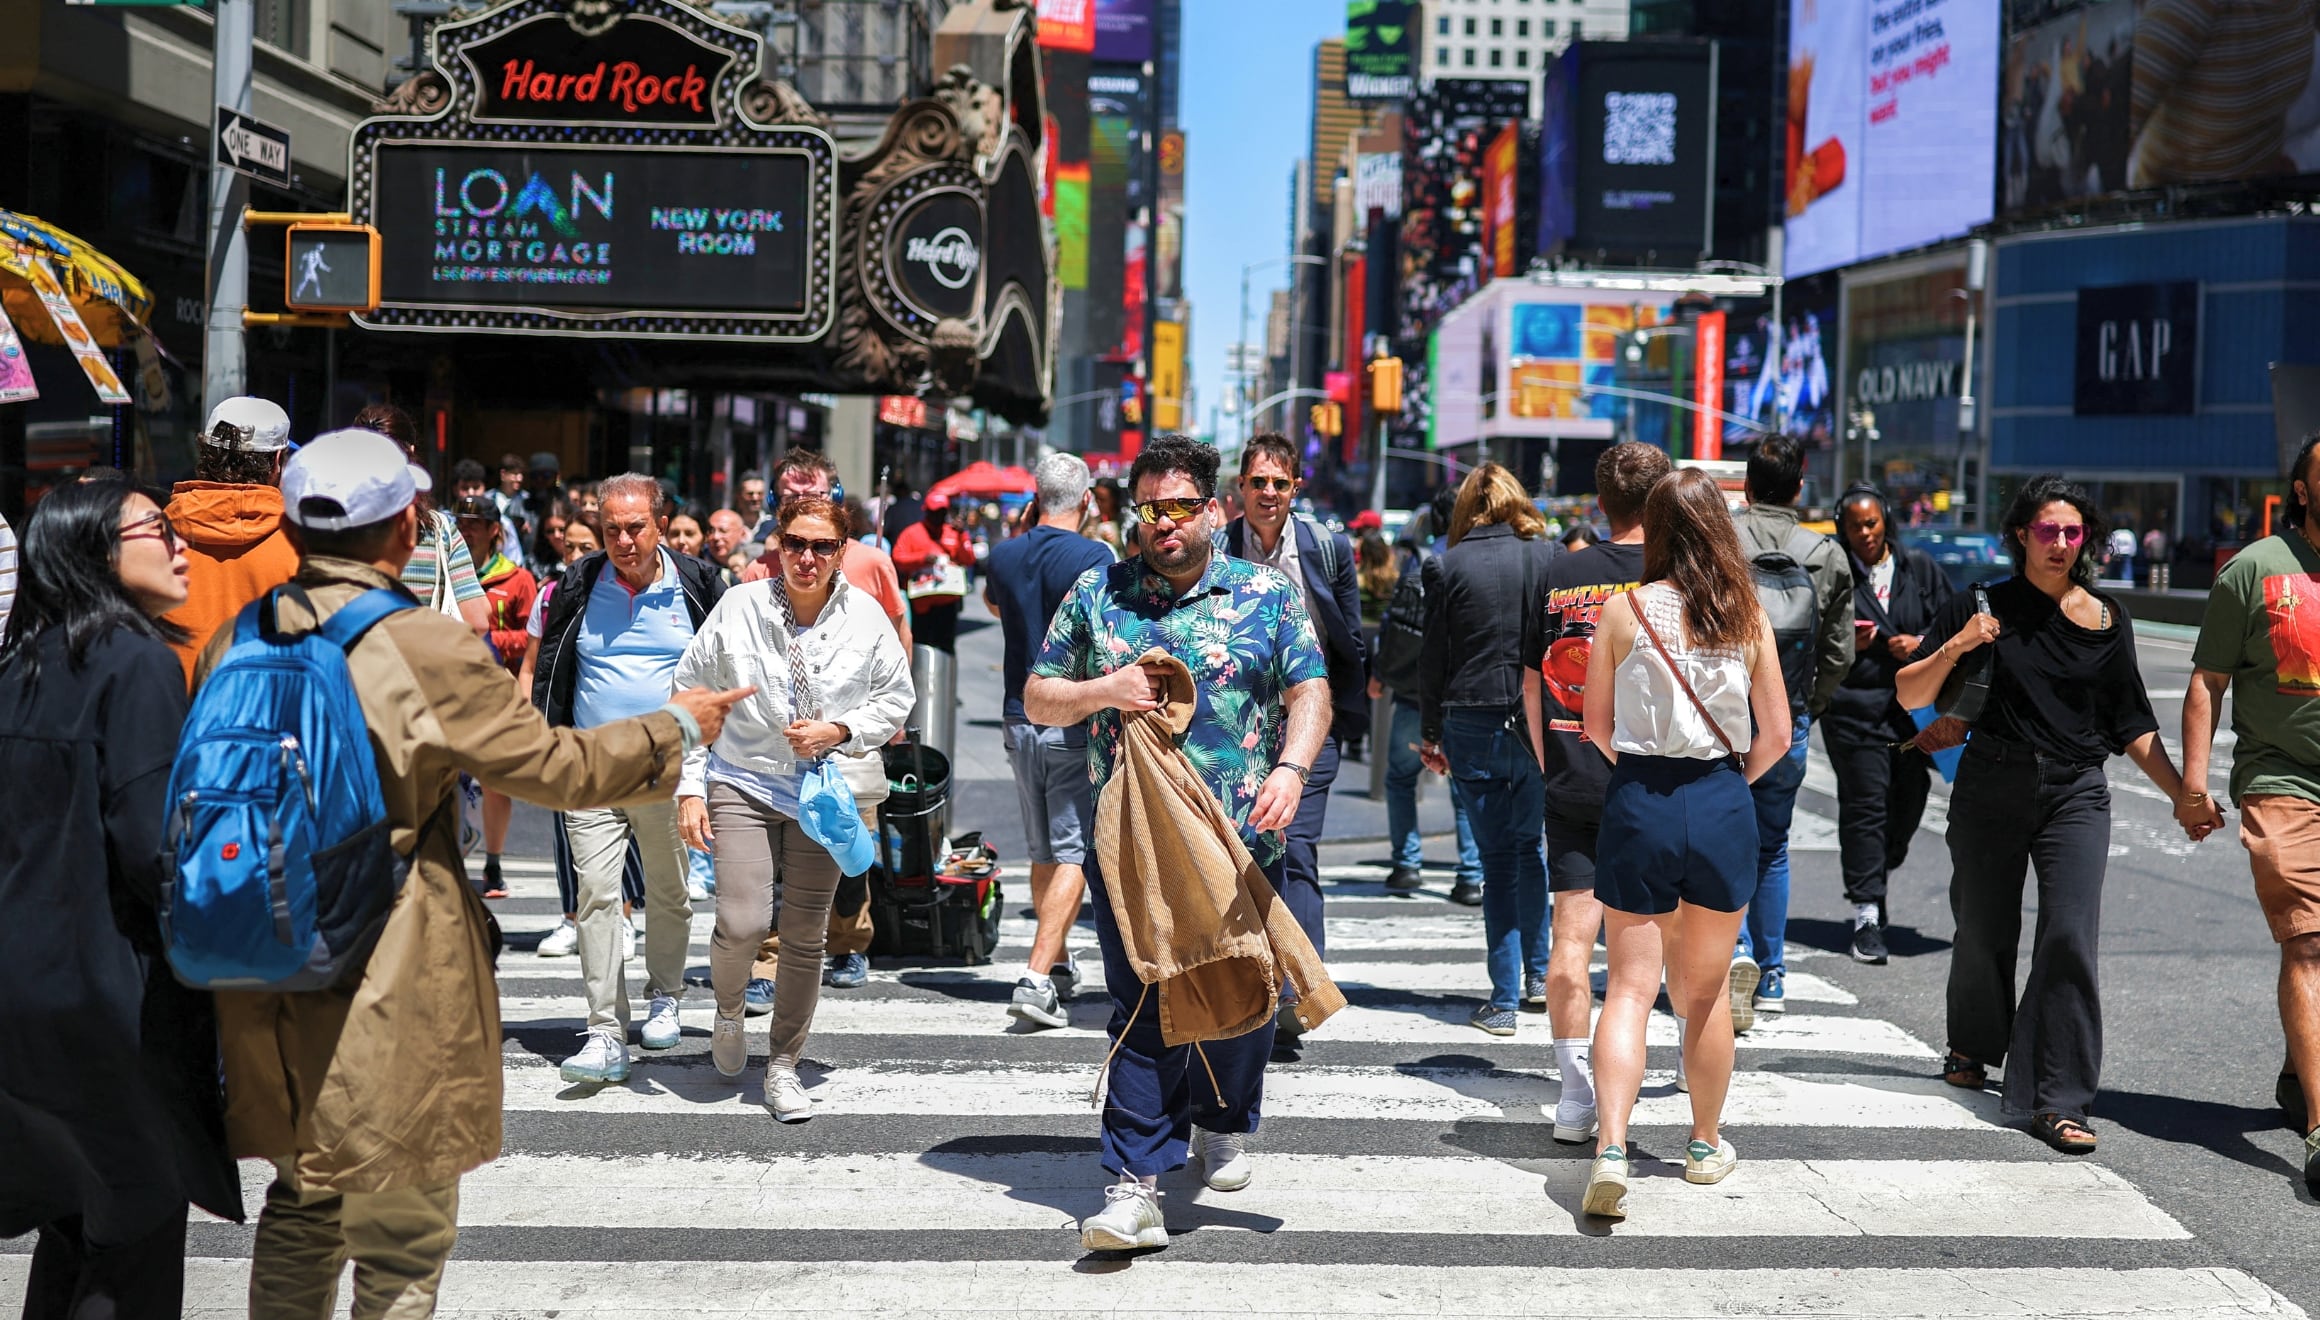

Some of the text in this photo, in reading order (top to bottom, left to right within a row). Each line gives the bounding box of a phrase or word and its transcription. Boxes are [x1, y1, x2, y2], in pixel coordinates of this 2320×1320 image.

[501, 58, 706, 112] Hard Rock
[229, 128, 281, 166] ONE WAY
[434, 168, 614, 221] LOAN
[434, 218, 539, 237] STREAM
[651, 206, 784, 231] NEW YORK
[434, 240, 611, 264] MORTGAGE
[678, 231, 756, 255] ROOM
[2099, 319, 2171, 380] GAP
[1857, 360, 1954, 403] OLD NAVY
